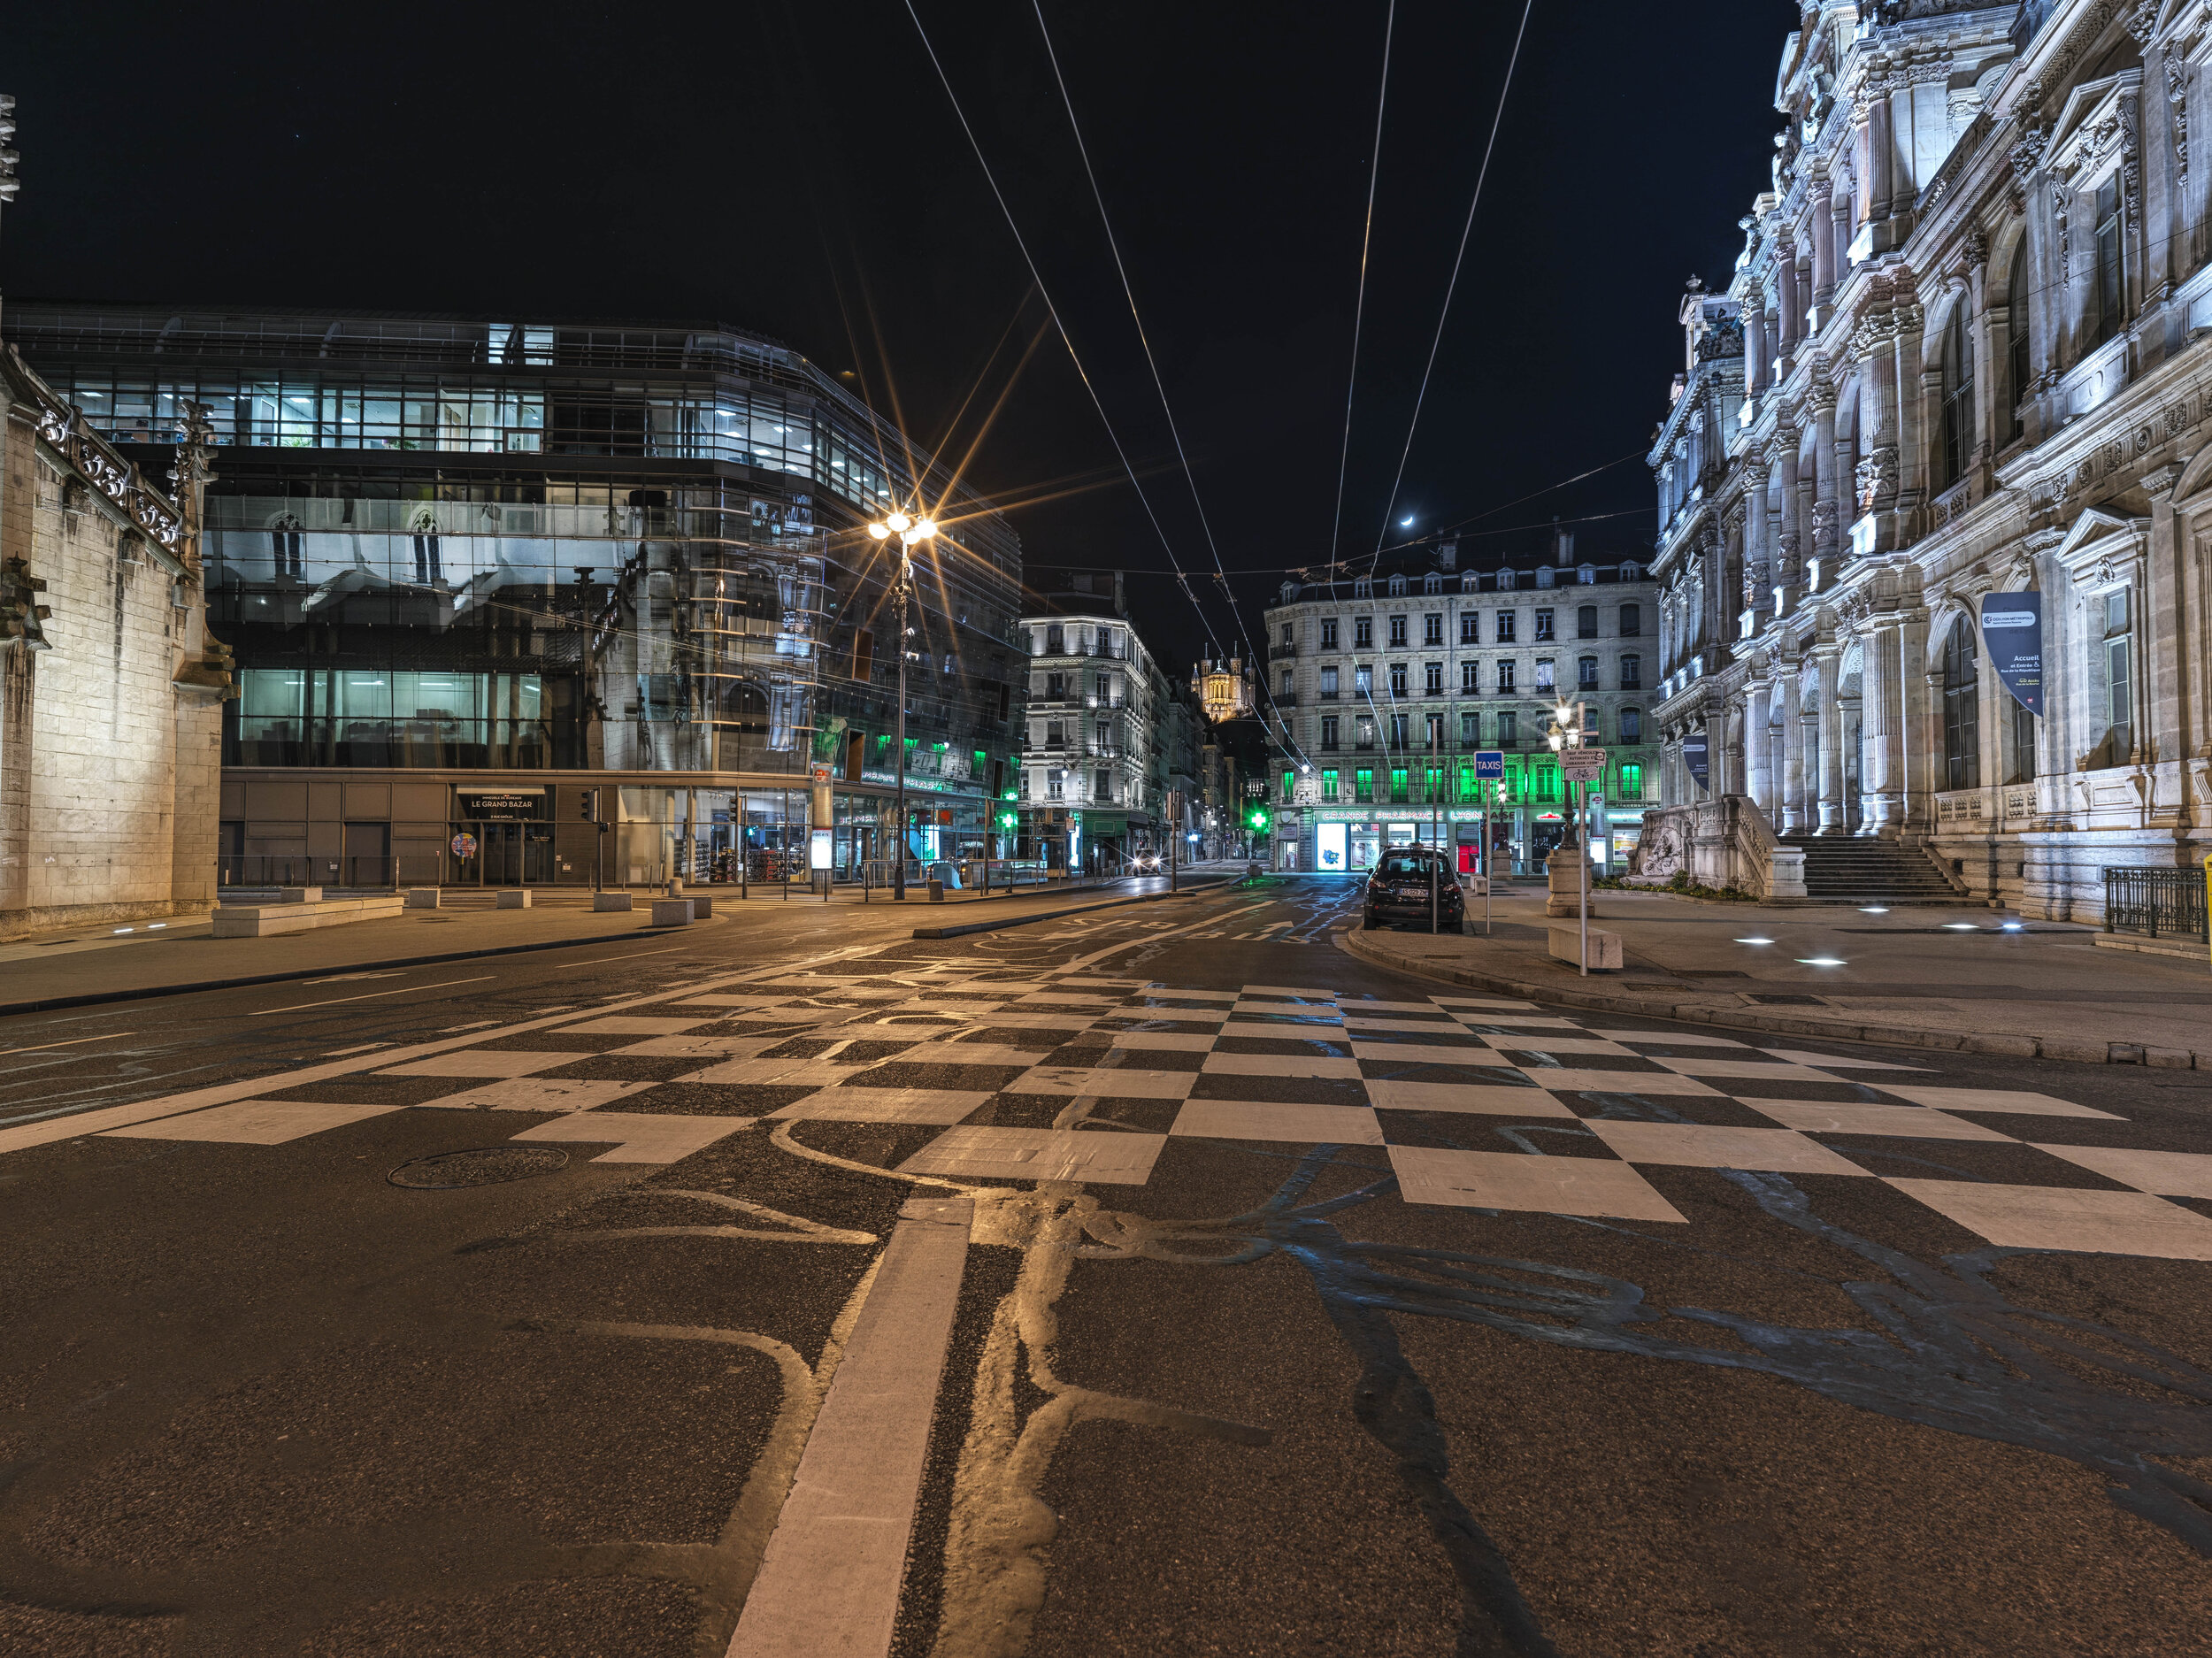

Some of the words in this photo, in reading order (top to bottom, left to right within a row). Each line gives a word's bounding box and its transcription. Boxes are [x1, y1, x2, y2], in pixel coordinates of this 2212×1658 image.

[1477, 761, 1502, 770] TAXIS
[1323, 811, 1369, 820] GRANDE
[1376, 811, 1444, 820] PHARMACE
[1451, 810, 1515, 819] LYONNASE
